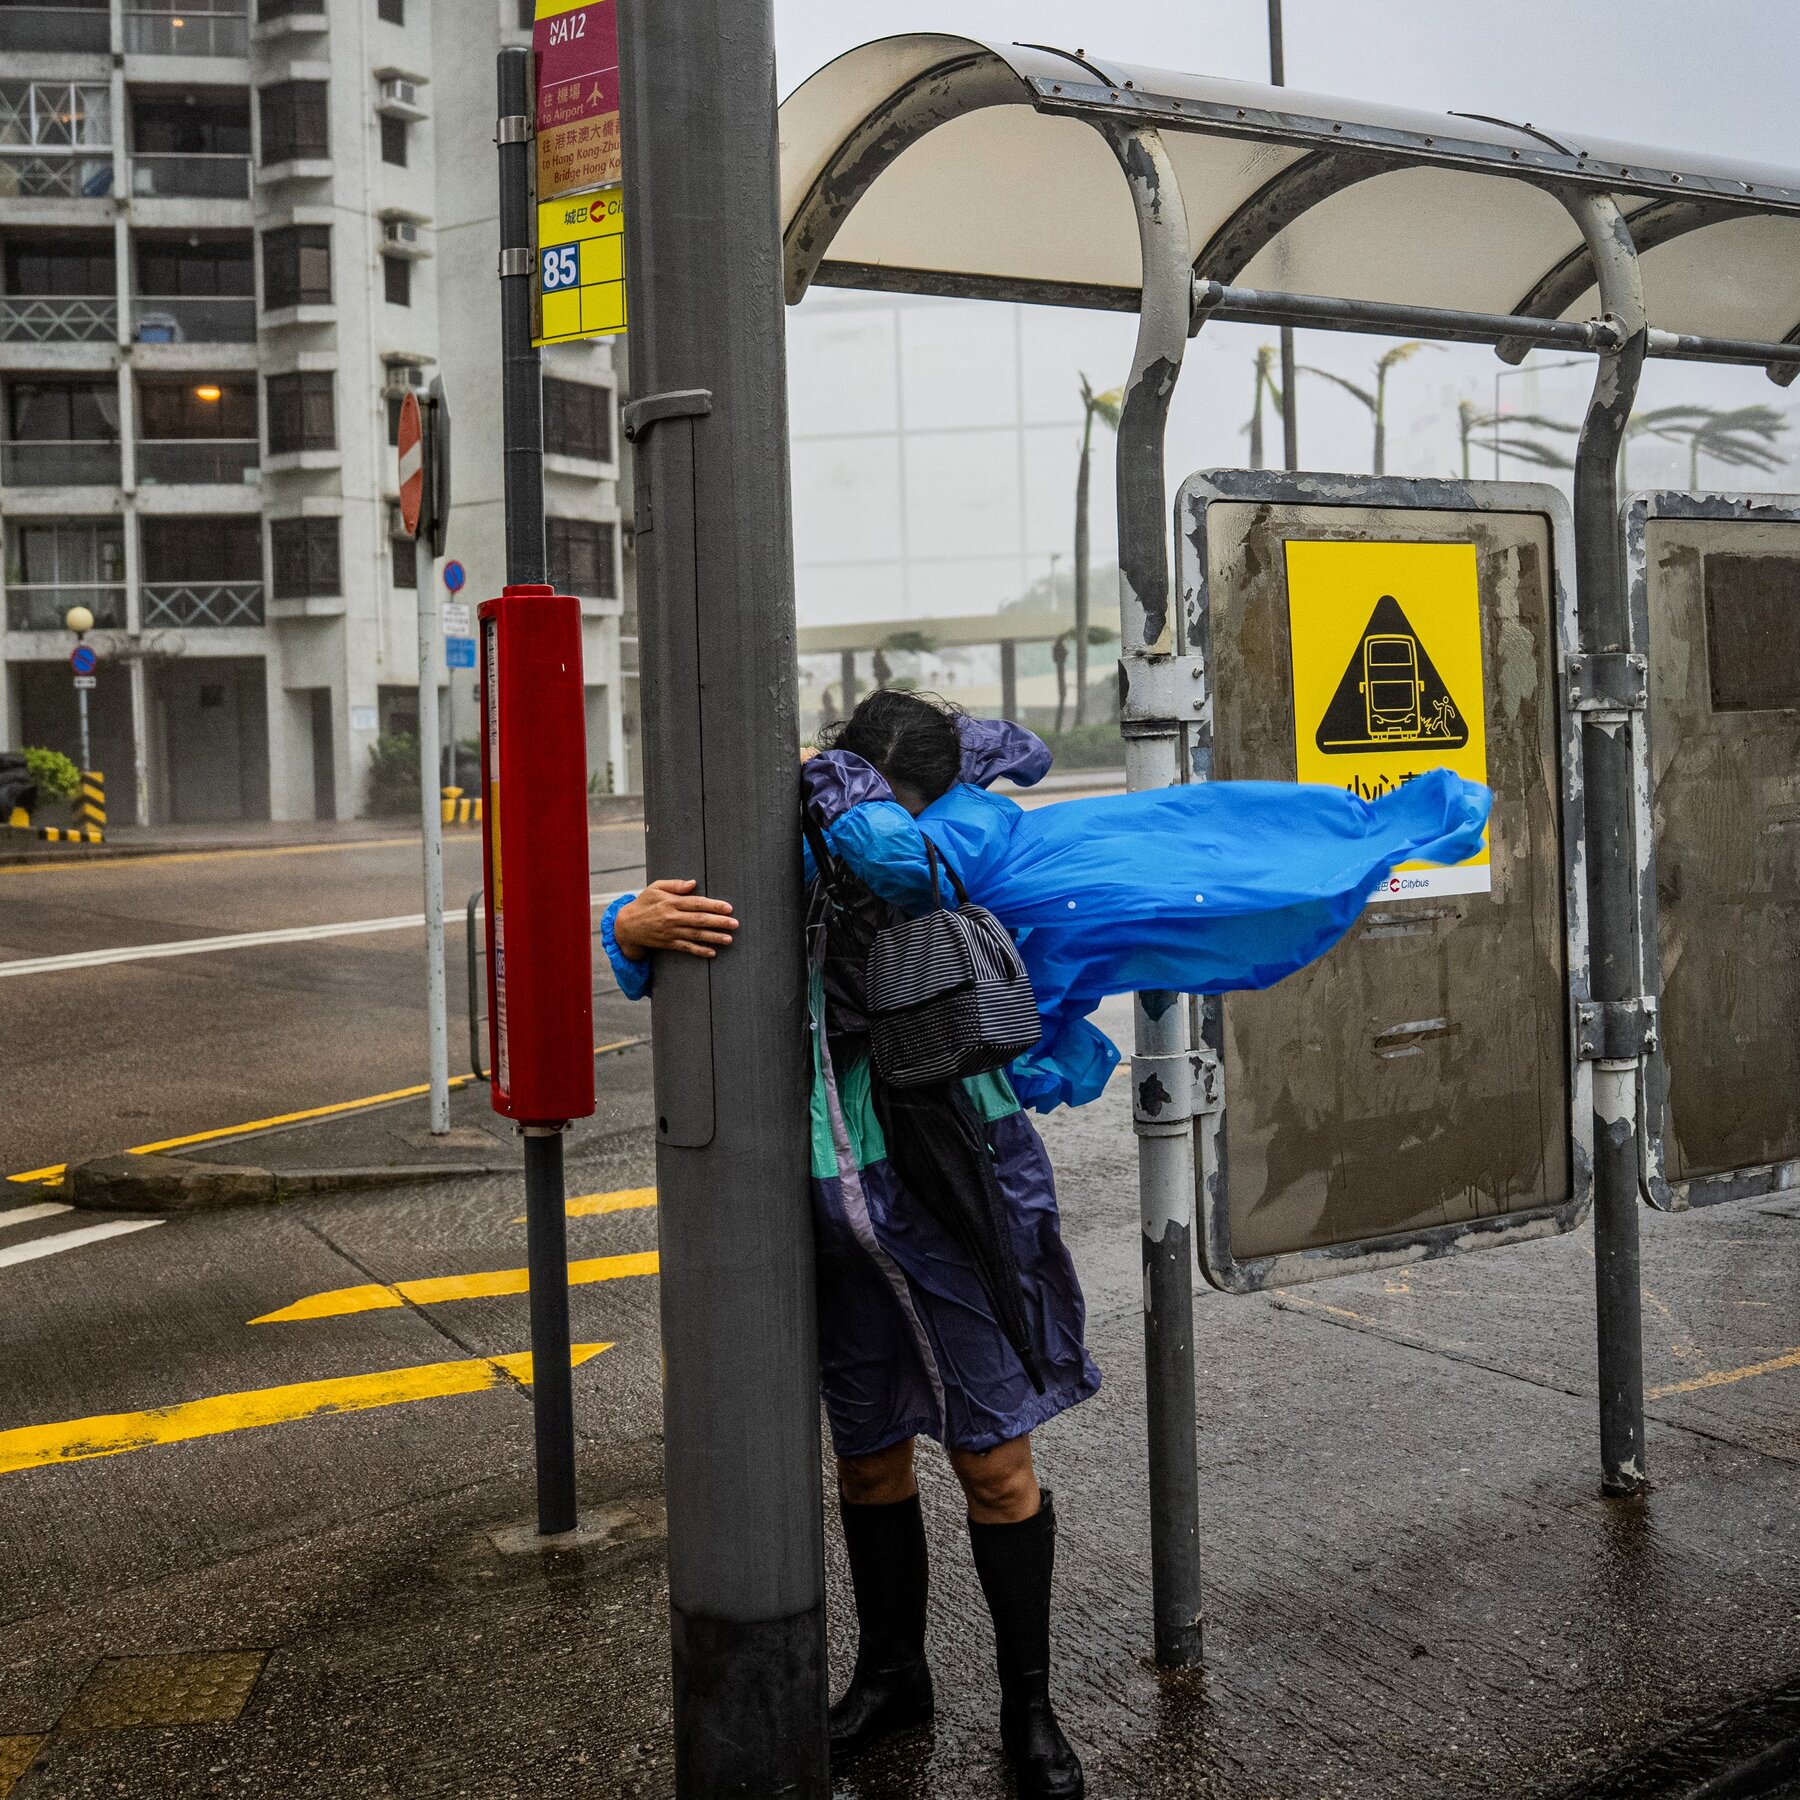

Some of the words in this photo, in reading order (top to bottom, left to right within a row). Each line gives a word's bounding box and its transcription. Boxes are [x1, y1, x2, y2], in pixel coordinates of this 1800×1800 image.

[543, 93, 553, 107] 往
[557, 82, 580, 104] 機場
[542, 113, 551, 124] to
[554, 104, 584, 122] Airport
[542, 139, 551, 153] 往
[542, 160, 551, 170] to
[552, 153, 574, 167] Hong
[554, 167, 581, 184] Bridge
[582, 161, 607, 176] Hong
[564, 207, 588, 225] 城巴
[543, 247, 577, 288] 85
[1401, 878, 1430, 890] Citybus
